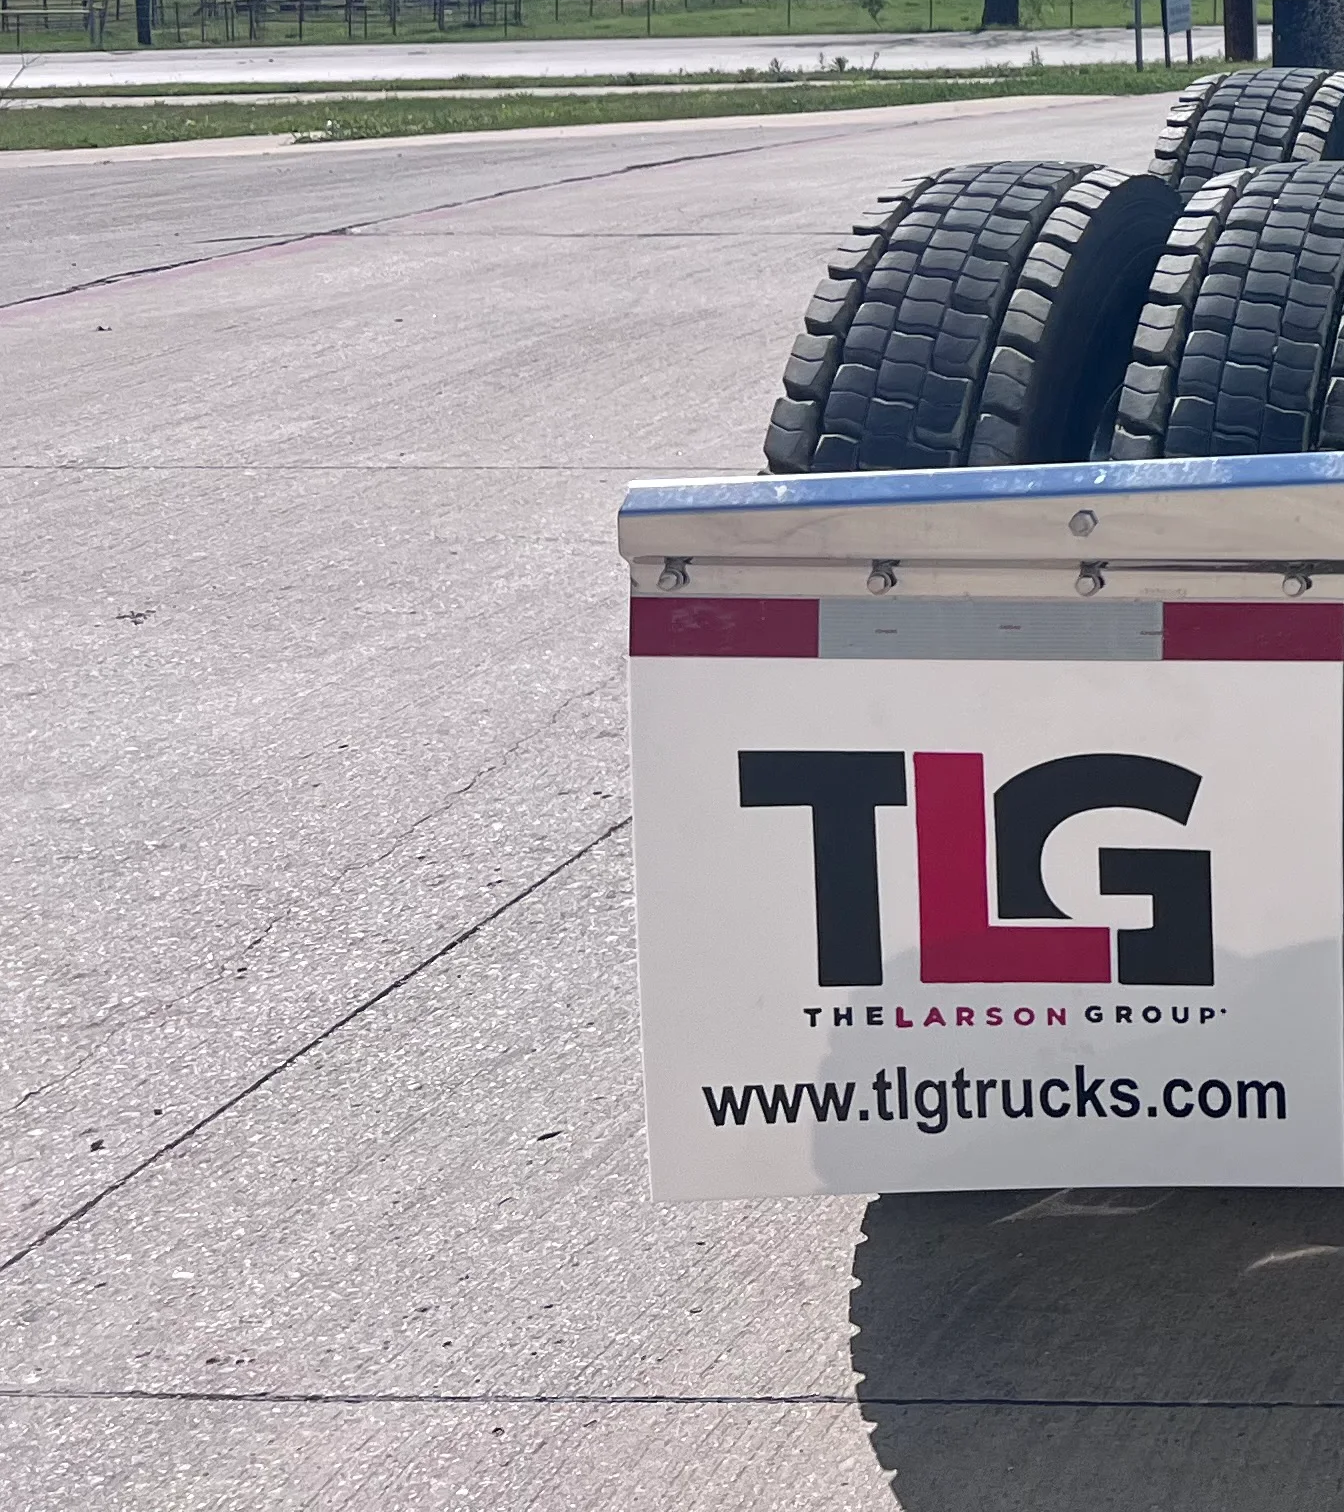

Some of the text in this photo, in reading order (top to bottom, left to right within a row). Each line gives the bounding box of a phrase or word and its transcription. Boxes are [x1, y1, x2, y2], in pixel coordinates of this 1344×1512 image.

[738, 751, 1214, 987] TLG
[1085, 1006, 1216, 1025] GROUP
[702, 1064, 1287, 1135] www.tlgtrucks.com
